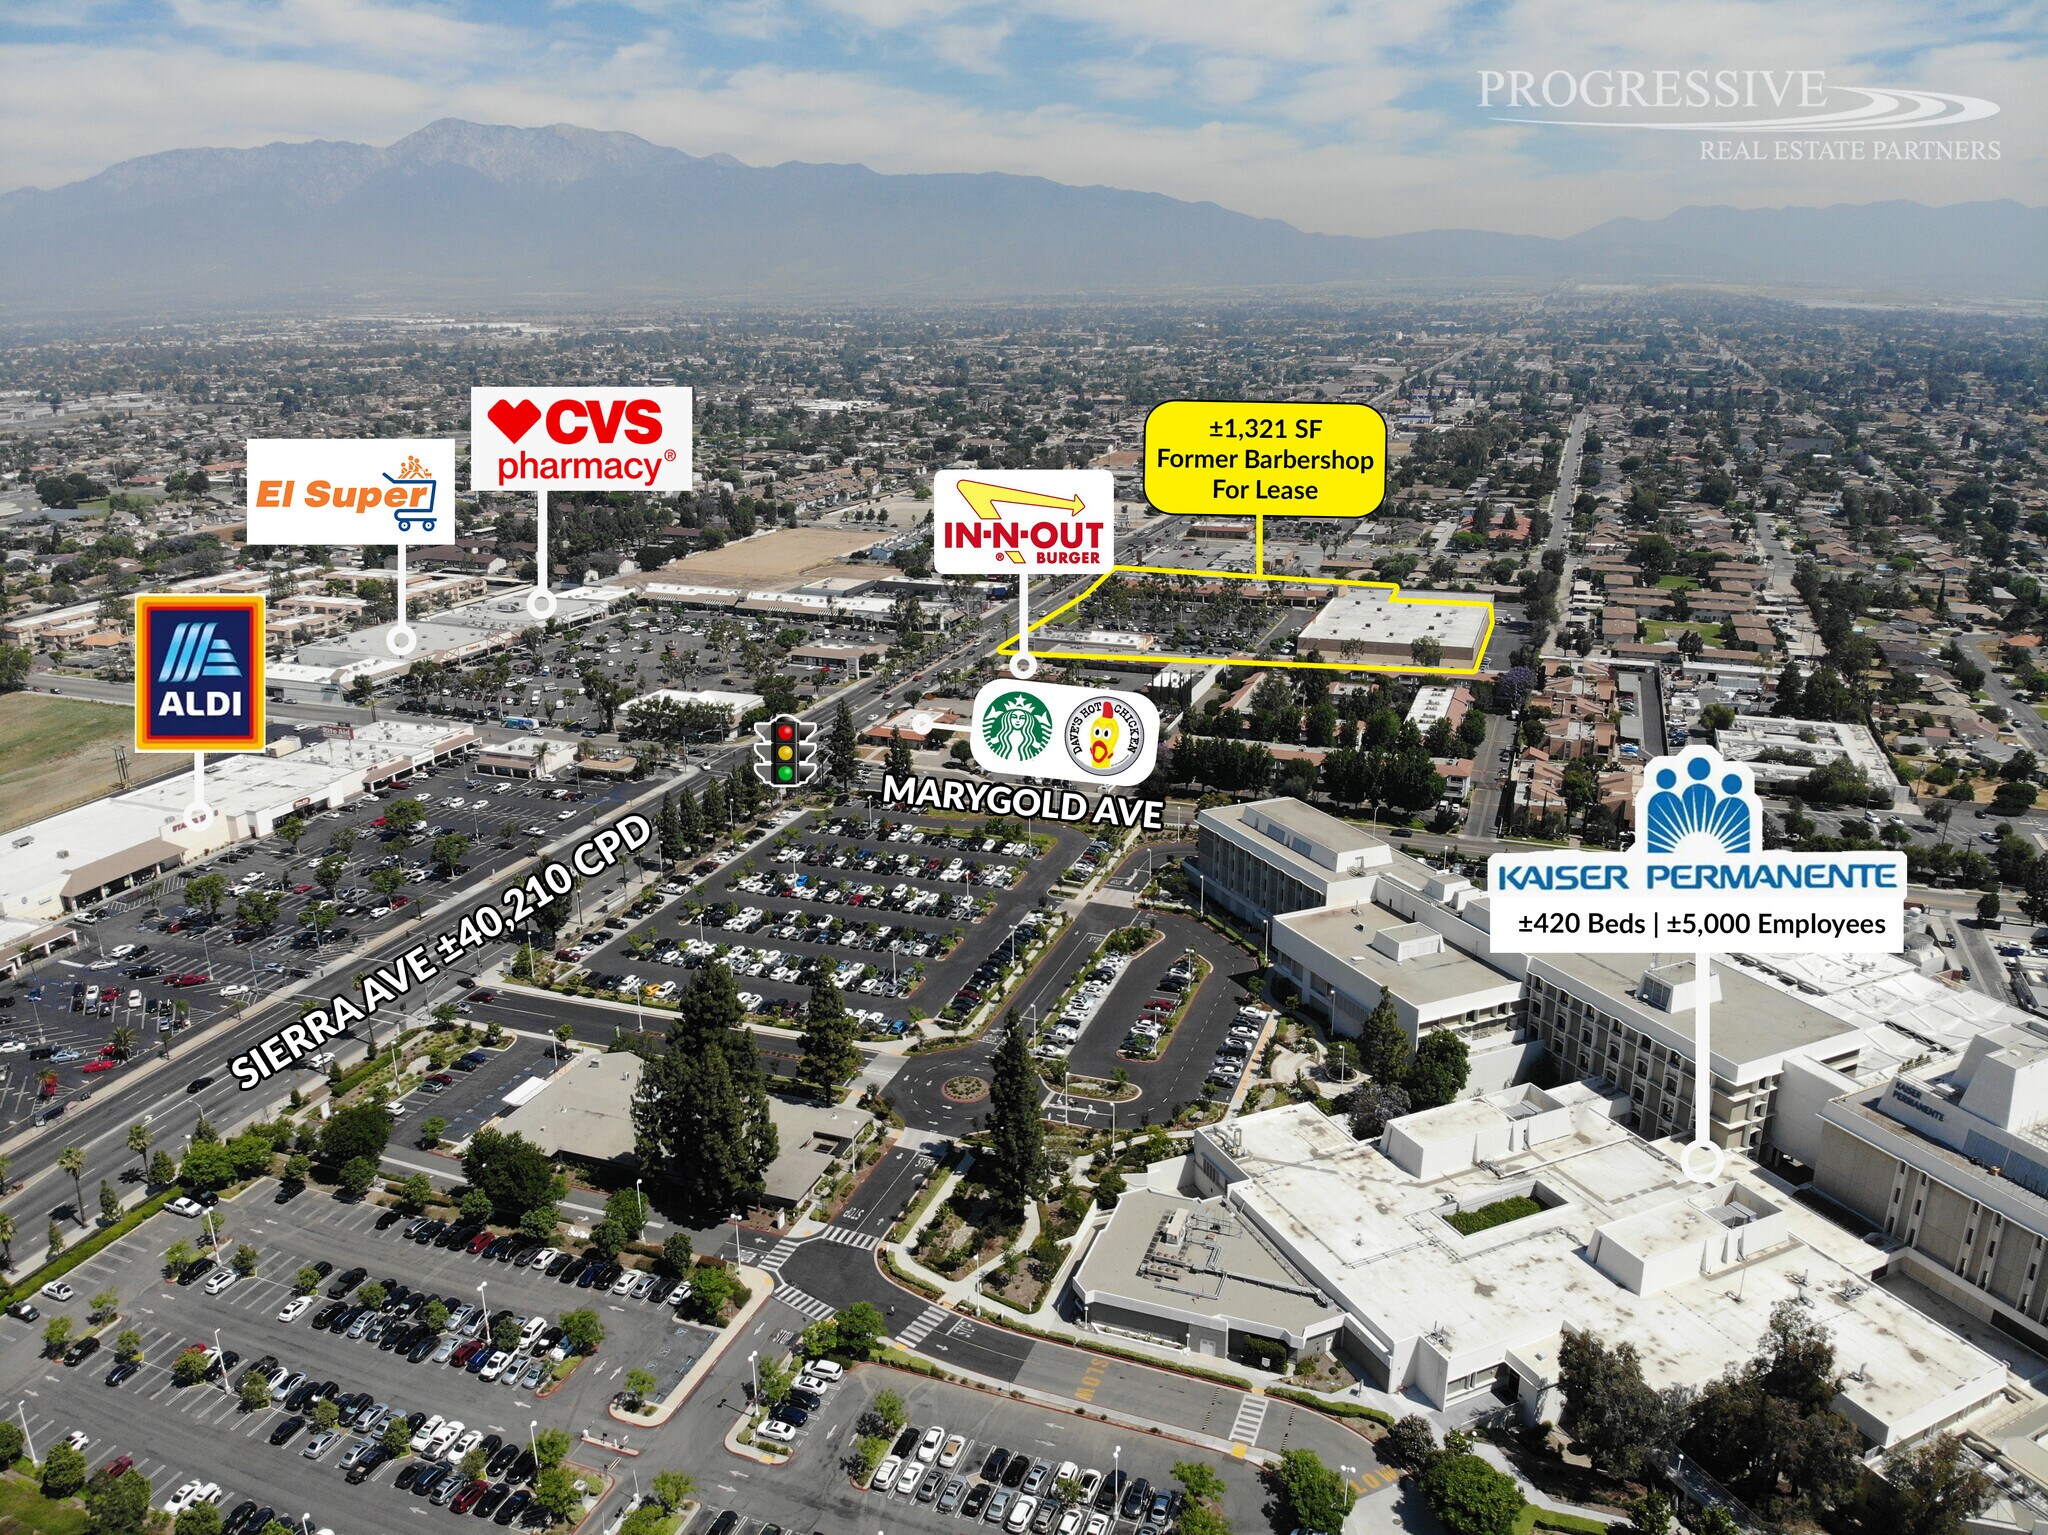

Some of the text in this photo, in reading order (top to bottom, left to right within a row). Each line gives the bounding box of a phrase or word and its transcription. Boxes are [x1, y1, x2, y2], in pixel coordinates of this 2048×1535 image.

[1895, 1081, 1922, 1100] KAISER
[1892, 1090, 1946, 1122] PERMANENTE
[1348, 1464, 1400, 1494] LOW
